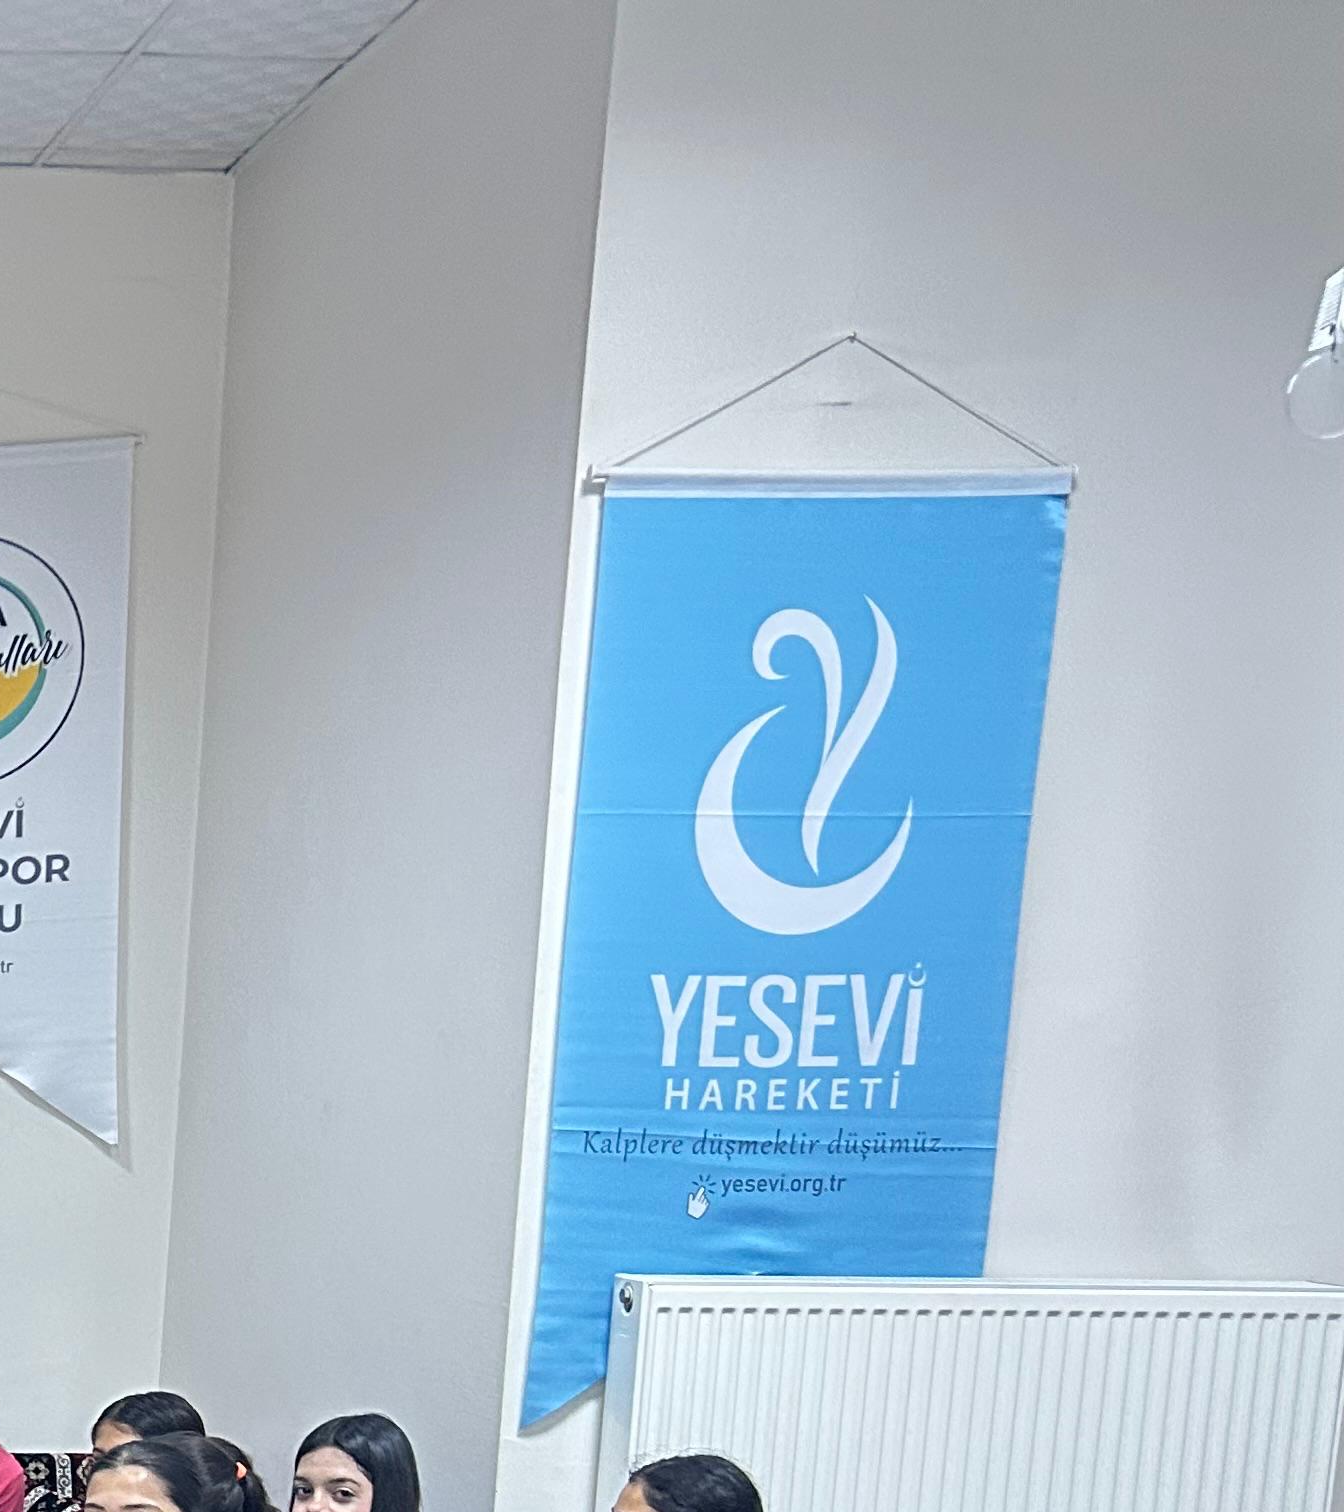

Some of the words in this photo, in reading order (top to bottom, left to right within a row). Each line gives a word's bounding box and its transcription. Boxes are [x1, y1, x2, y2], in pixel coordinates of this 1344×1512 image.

[650, 961, 927, 1068] YESEVİ
[664, 1070, 901, 1111] HAREKETİ
[582, 1127, 683, 1162] Kalplere
[692, 1128, 820, 1162] düşmektir
[721, 1173, 847, 1198] yesevi.org.tr
